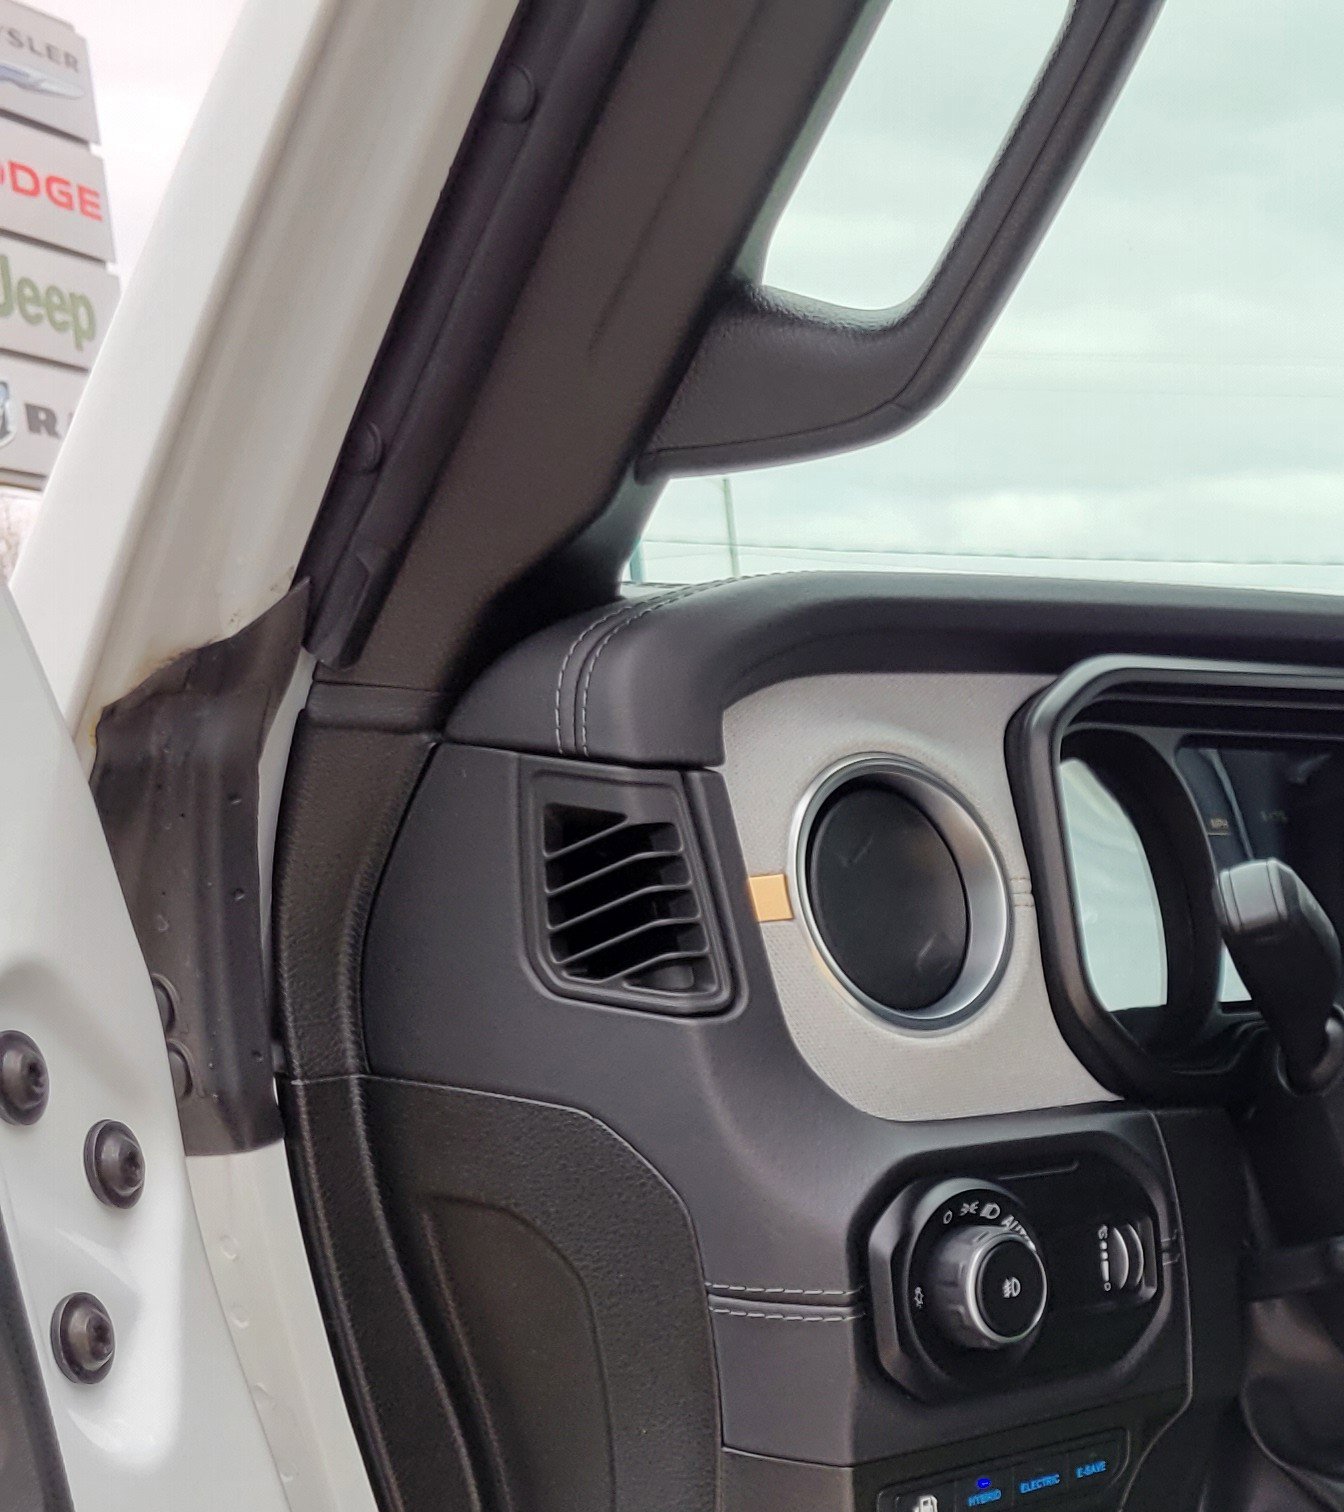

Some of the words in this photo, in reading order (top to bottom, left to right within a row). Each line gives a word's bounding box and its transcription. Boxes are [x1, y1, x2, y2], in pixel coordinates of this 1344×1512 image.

[0, 26, 79, 73] SLER
[0, 160, 103, 222] DGE
[24, 403, 74, 440] R
[1019, 1474, 1060, 1494] ELECTRIC
